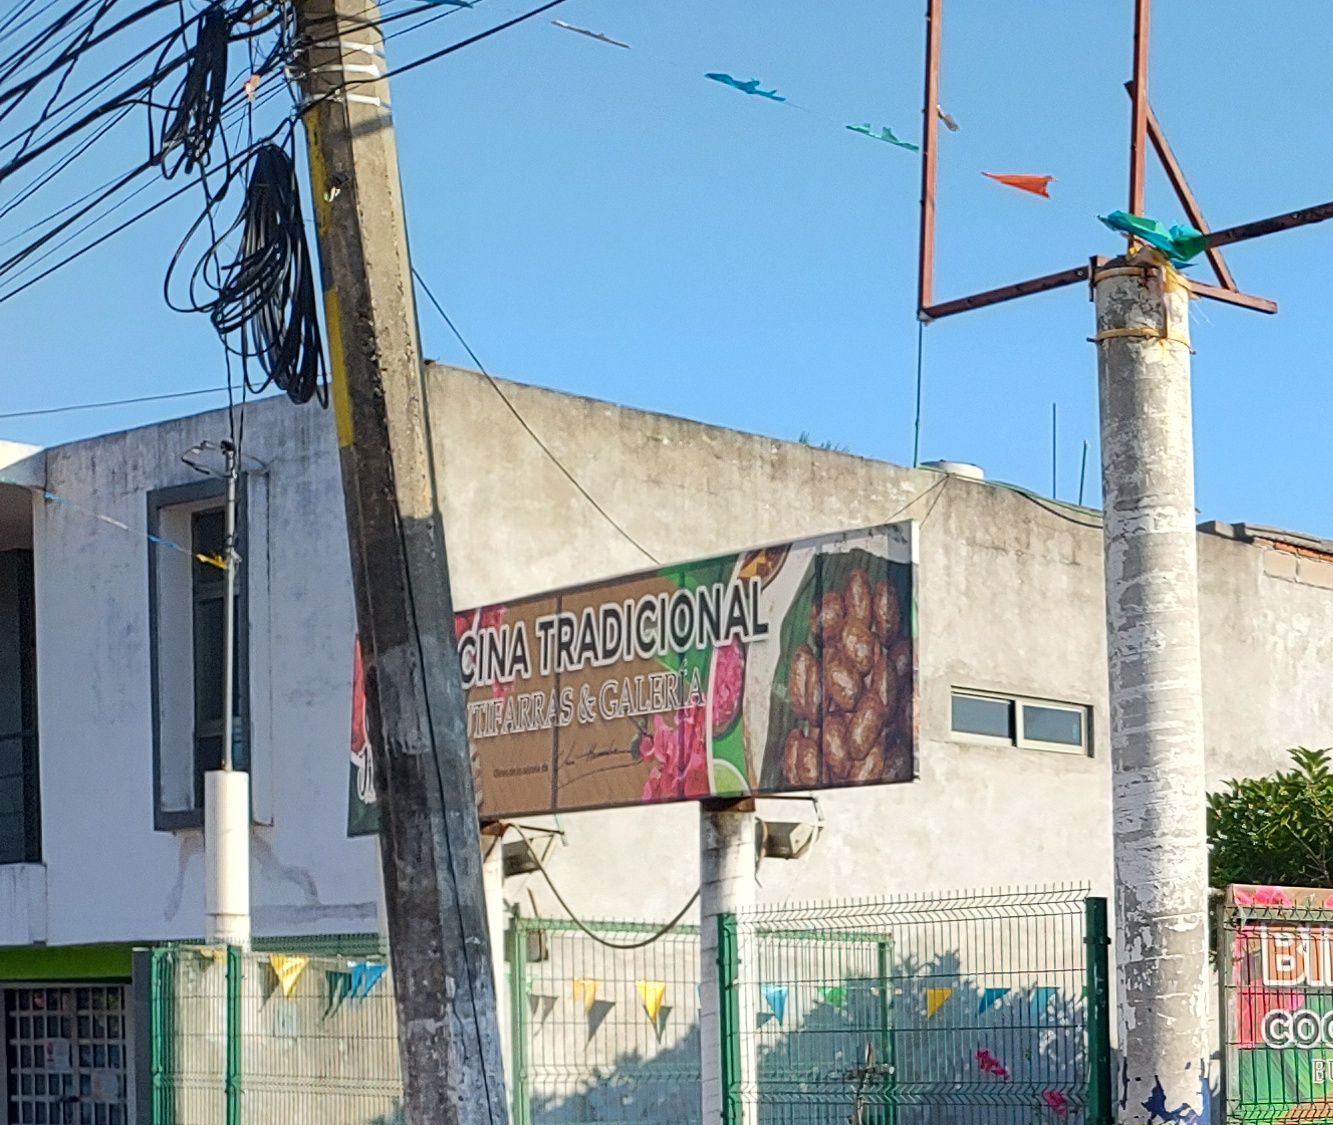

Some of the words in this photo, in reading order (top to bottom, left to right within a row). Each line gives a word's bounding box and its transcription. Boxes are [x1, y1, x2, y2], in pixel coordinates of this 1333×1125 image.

[459, 620, 531, 690] CINA
[537, 576, 770, 676] TRADICIONAL
[467, 686, 574, 739] TIFARRAS
[578, 684, 597, 724] &
